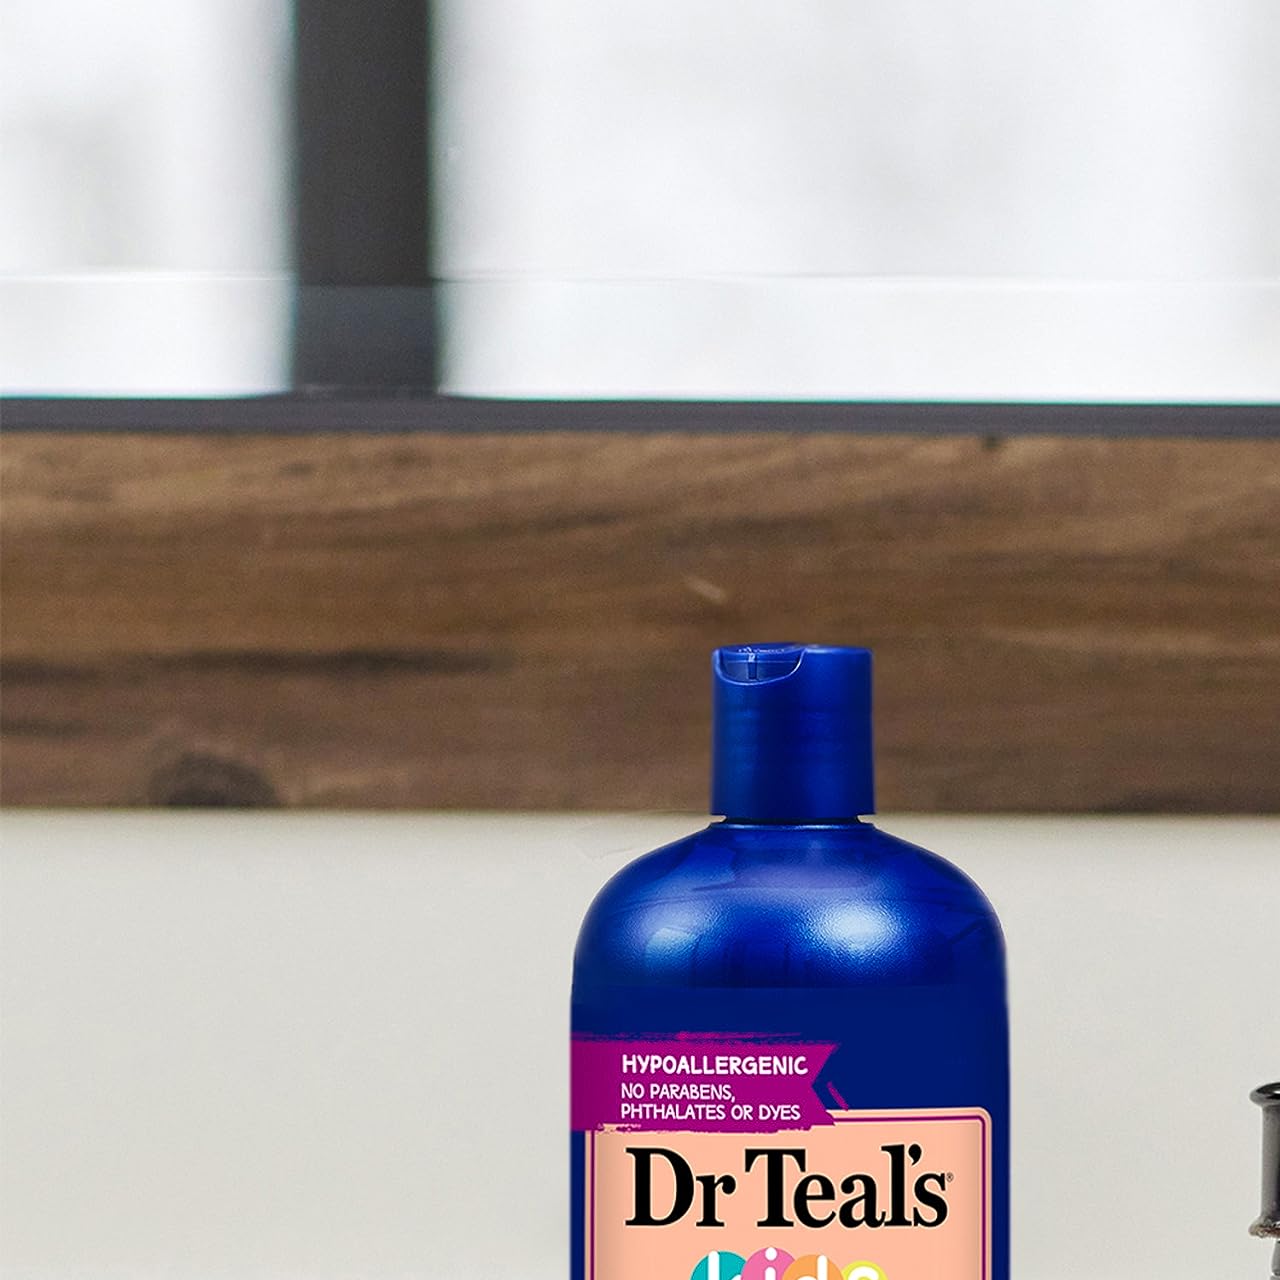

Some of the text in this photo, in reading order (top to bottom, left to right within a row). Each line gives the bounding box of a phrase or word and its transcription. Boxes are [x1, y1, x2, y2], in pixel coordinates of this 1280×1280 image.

[621, 1054, 809, 1076] HYPOALLERGENIC
[620, 1082, 736, 1103] NO PARABENS,
[620, 1103, 801, 1121] PHTHALATES OR DYES
[625, 1147, 737, 1227] Dr
